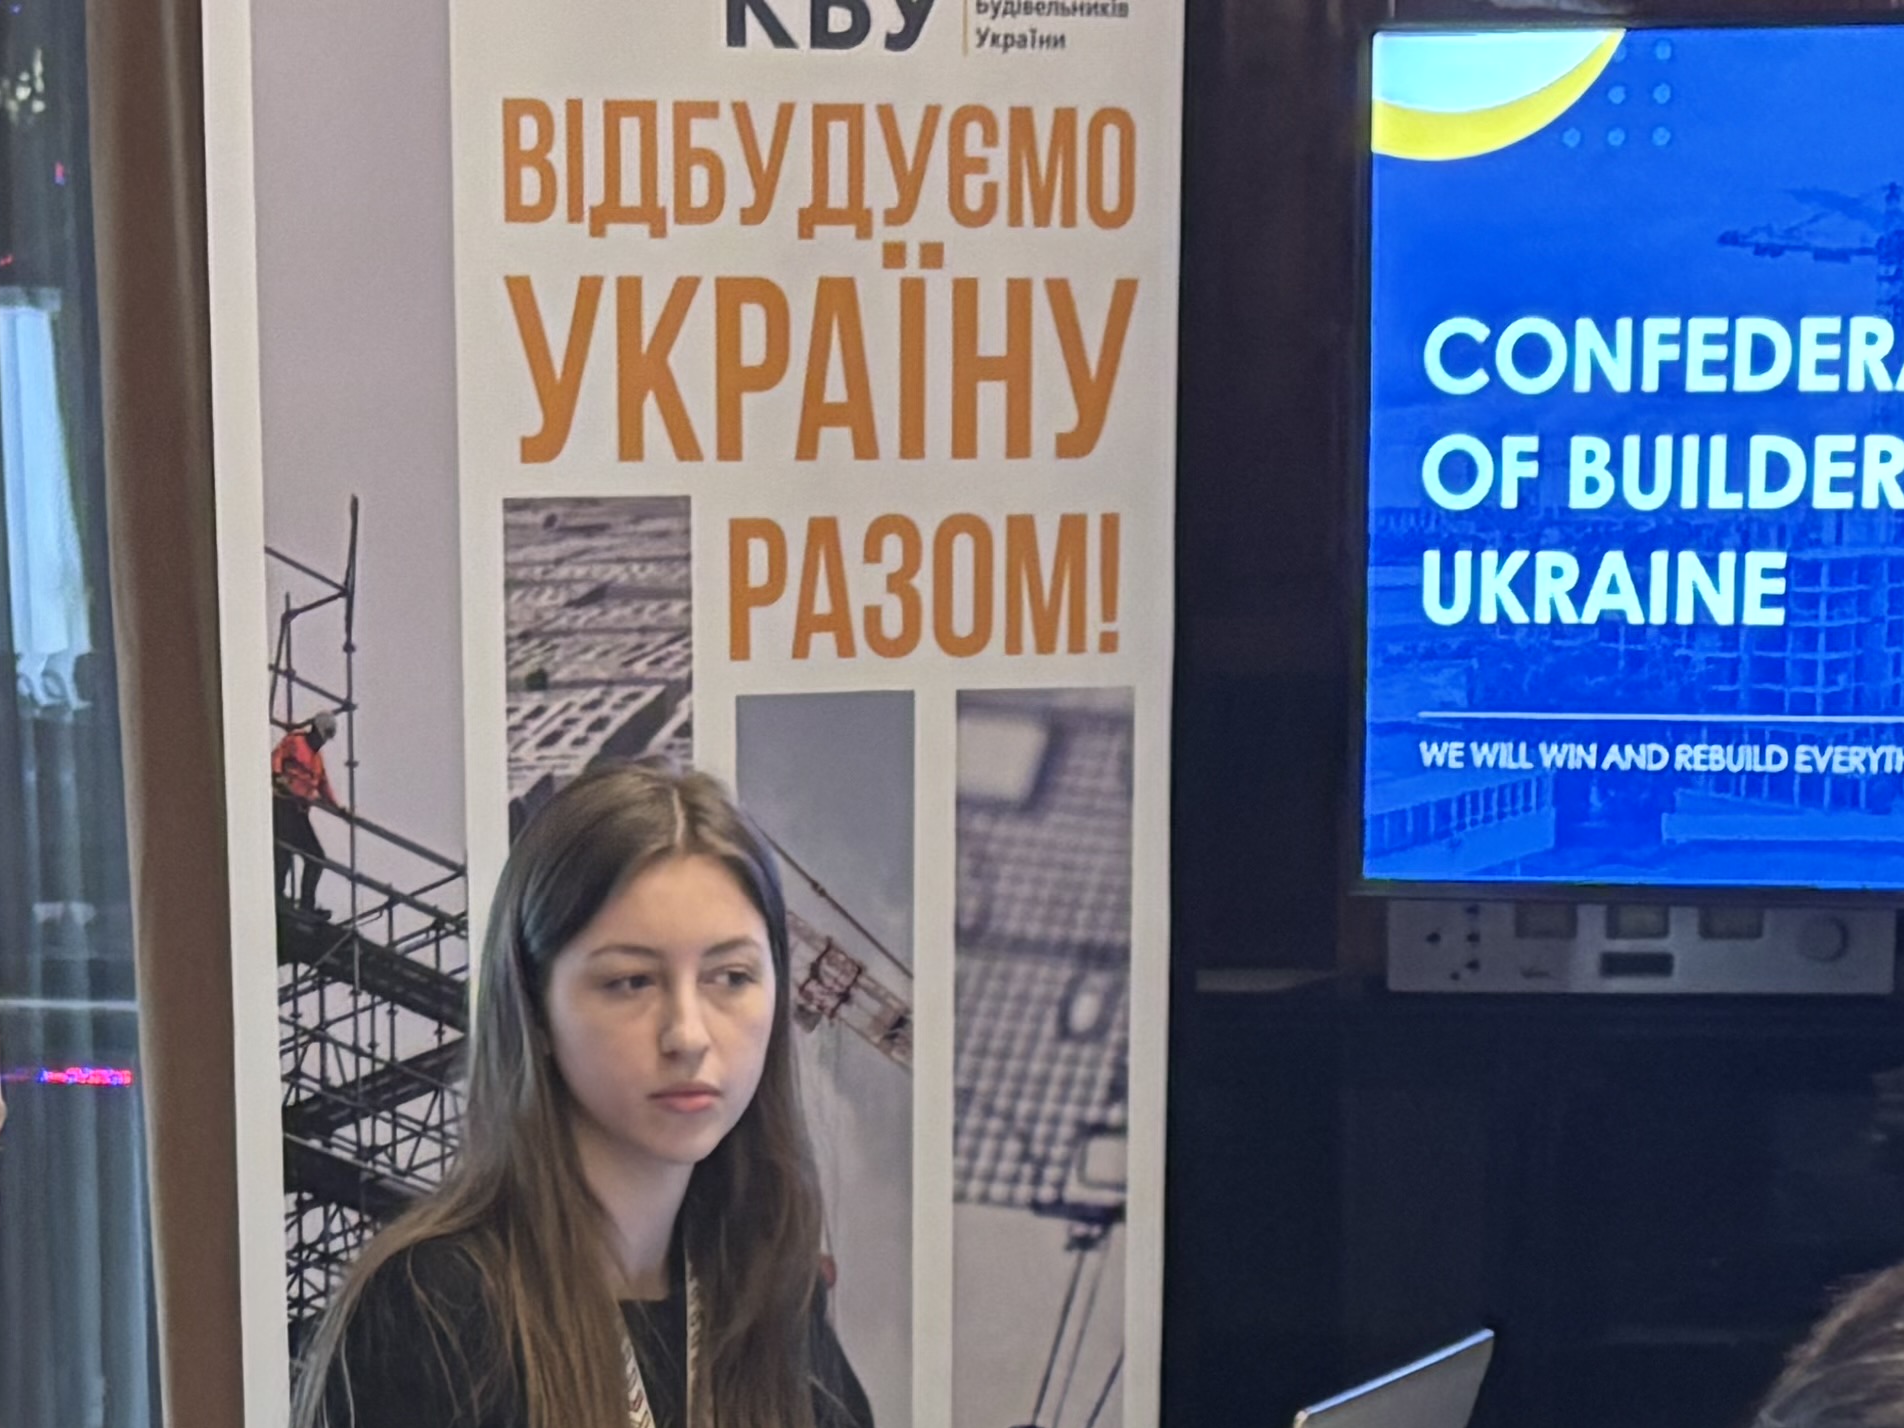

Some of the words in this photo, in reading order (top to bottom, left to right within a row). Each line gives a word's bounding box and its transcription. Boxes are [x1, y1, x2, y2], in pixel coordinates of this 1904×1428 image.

[976, 28, 1067, 52] України
[501, 97, 1137, 241] ВІДБУДУЄМО
[502, 241, 1139, 465] УКРАЇНУ
[1421, 432, 1539, 512] OF
[728, 512, 1121, 663] РАЗОМ!
[1421, 548, 1788, 627] UKRAINE
[1419, 741, 1465, 769] WE
[1470, 741, 1534, 770] WILL
[1538, 741, 1597, 771] WIN
[1601, 742, 1669, 771] AND
[1674, 743, 1788, 773] REBUILD
